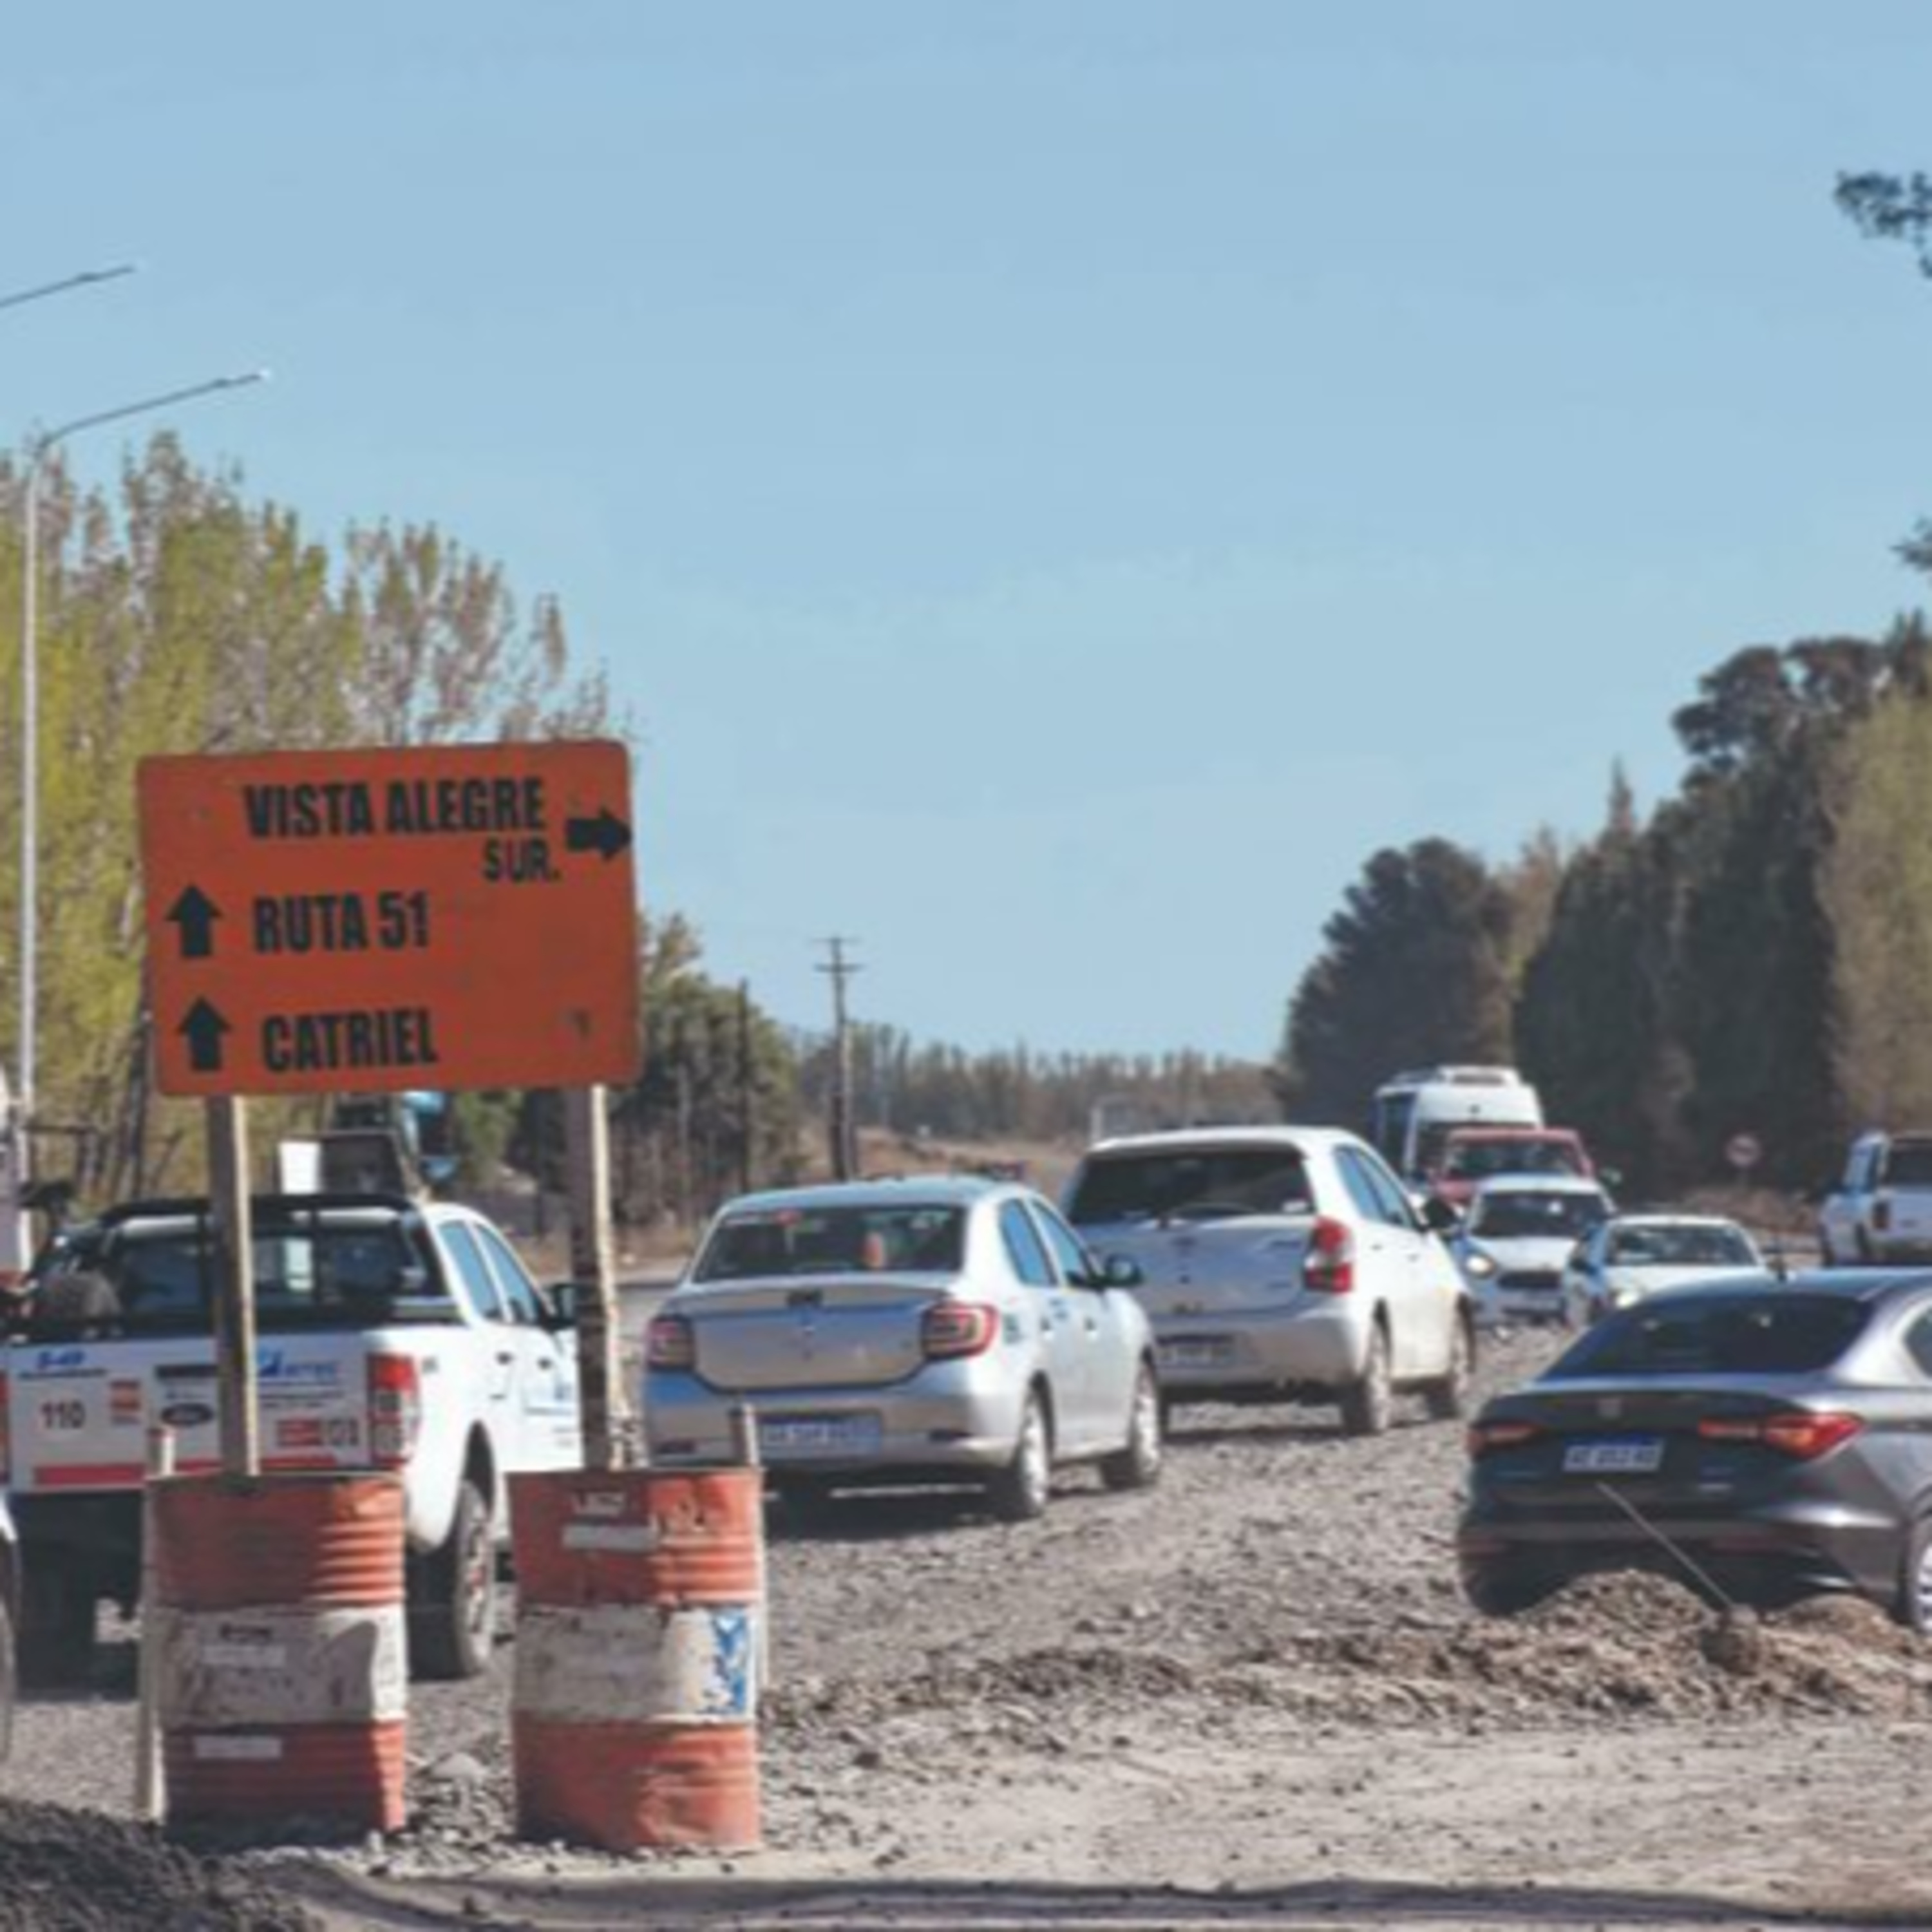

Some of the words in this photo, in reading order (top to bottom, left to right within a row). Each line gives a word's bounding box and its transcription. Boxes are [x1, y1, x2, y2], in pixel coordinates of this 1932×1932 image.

[244, 782, 375, 838] VISTA
[386, 777, 546, 833] ALEGRE
[253, 895, 369, 953] RUTA
[378, 891, 428, 949] 51
[262, 1009, 437, 1072] CATRIEL
[42, 1400, 86, 1430] 110
